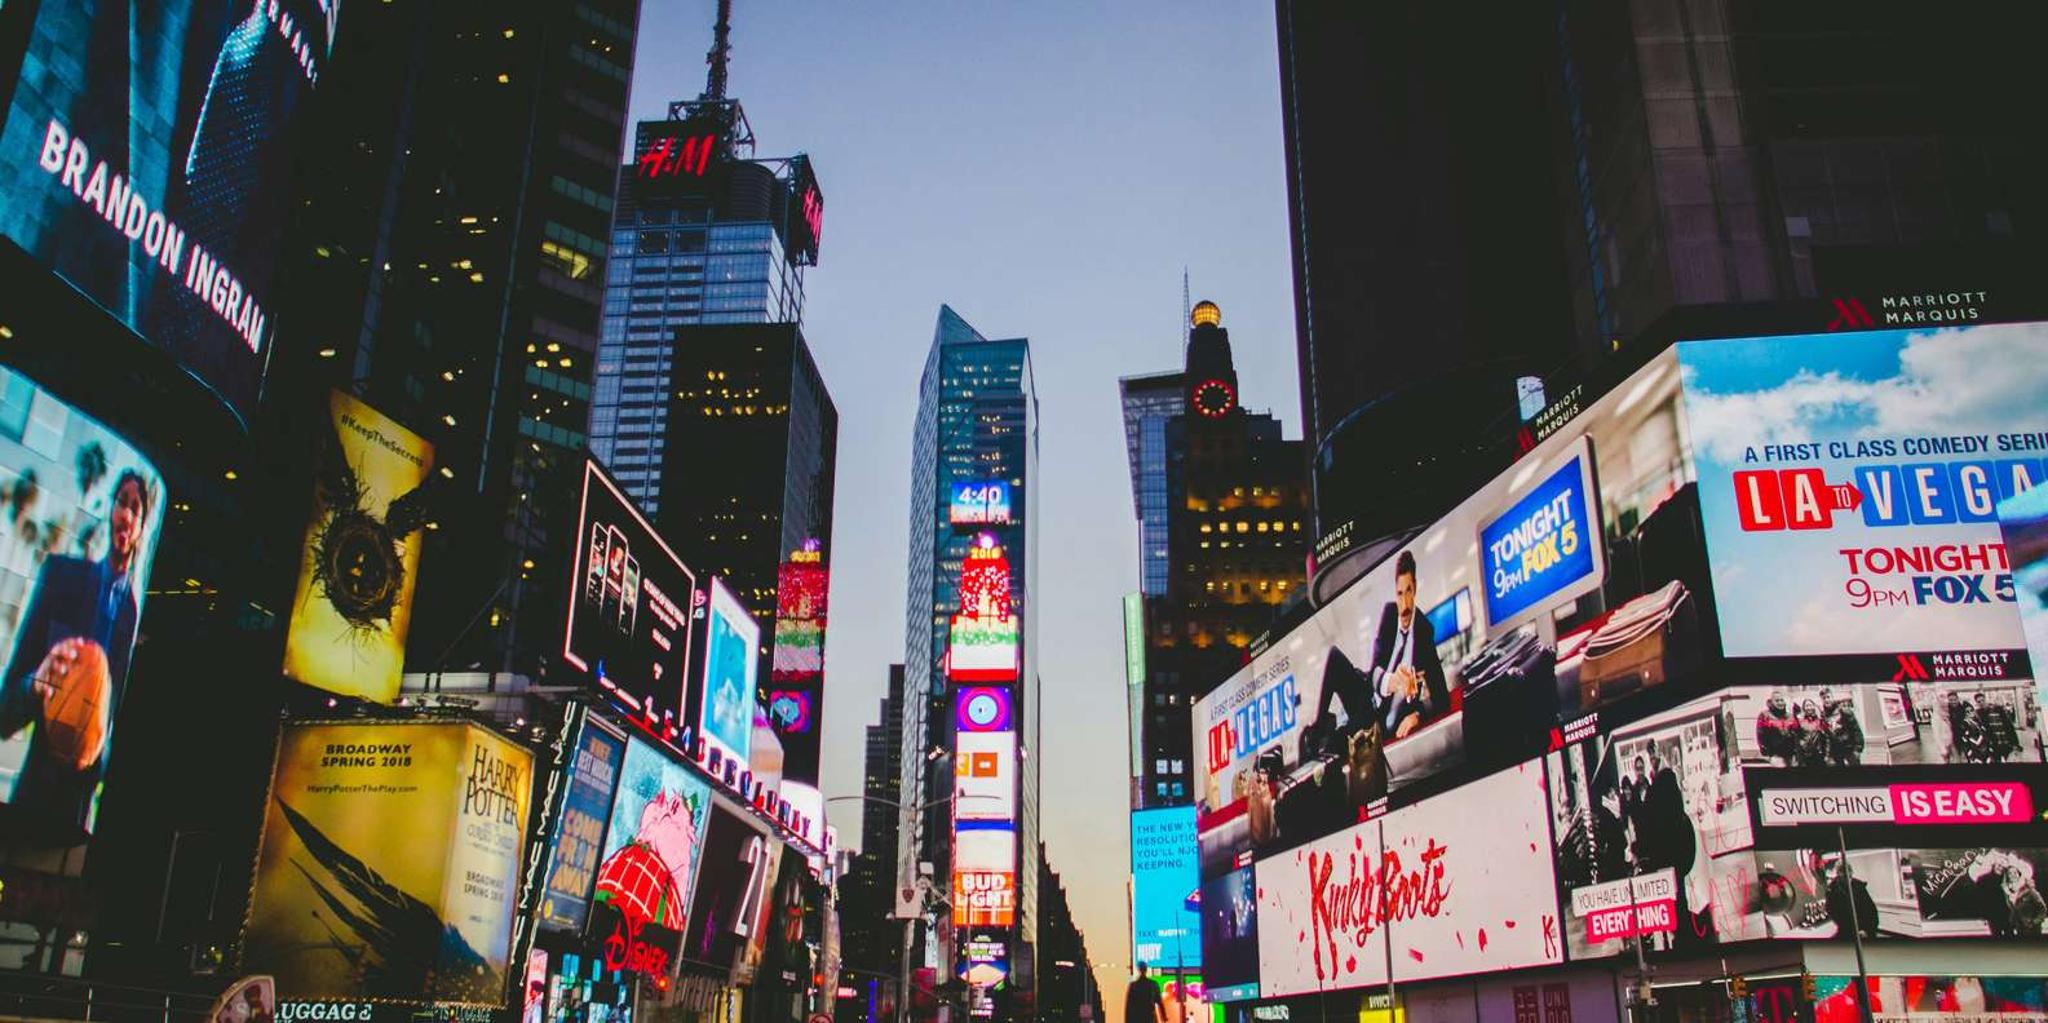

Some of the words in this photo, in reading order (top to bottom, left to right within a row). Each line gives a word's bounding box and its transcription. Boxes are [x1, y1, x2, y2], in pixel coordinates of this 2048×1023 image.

[40, 119, 186, 275] BRANDON
[185, 245, 265, 354] INGRAM
[1882, 291, 1987, 308] MARRIOTT
[1886, 308, 1979, 324] MARQUIS
[1535, 385, 1582, 428] MARRIOTT
[1537, 405, 1579, 441] MARQUIS
[1745, 446, 1759, 464] A
[1765, 443, 1823, 462] FIRST
[1829, 439, 1897, 459] CLASS
[1903, 435, 1989, 456] COMEDY
[1997, 432, 2048, 451] SERI
[959, 486, 1002, 500] 4:40
[1747, 474, 1822, 524] LA
[1833, 486, 1851, 508] TO
[1490, 489, 1572, 568] TONIGHT
[1494, 567, 1523, 599] 9PM
[1521, 534, 1561, 582] FOX
[1561, 521, 1578, 555] 5
[1840, 543, 2010, 575] TONIGHT
[1845, 578, 1910, 608] 9PM
[1913, 575, 1991, 604] FOX
[1994, 574, 2016, 602] 5
[1933, 653, 2009, 667] MARRIOTT
[1935, 664, 2002, 678] MARQUIS
[1237, 680, 1293, 755] VEGAS
[321, 757, 376, 768] SPRING
[382, 757, 412, 768] 2018
[325, 743, 412, 755] BROADWAY
[473, 744, 524, 798] HARRY
[307, 784, 418, 795] HarryPotterThePlay.com
[463, 776, 521, 832] POTTER
[1774, 796, 1886, 816] SWITCHING
[1901, 791, 1930, 817] IS
[1935, 789, 2014, 816] EASY
[1137, 824, 1156, 833] THE
[1160, 822, 1183, 832] NEW
[955, 889, 1012, 907] LIGHT
[962, 874, 1006, 890] BUD
[1619, 879, 1670, 904] UNIMITED
[1308, 852, 1375, 981] Kinky
[1374, 838, 1450, 926] Boots
[1592, 903, 1670, 936] EVERYHING
[1542, 915, 1557, 958] K
[275, 1003, 373, 1020] UGGAGE
